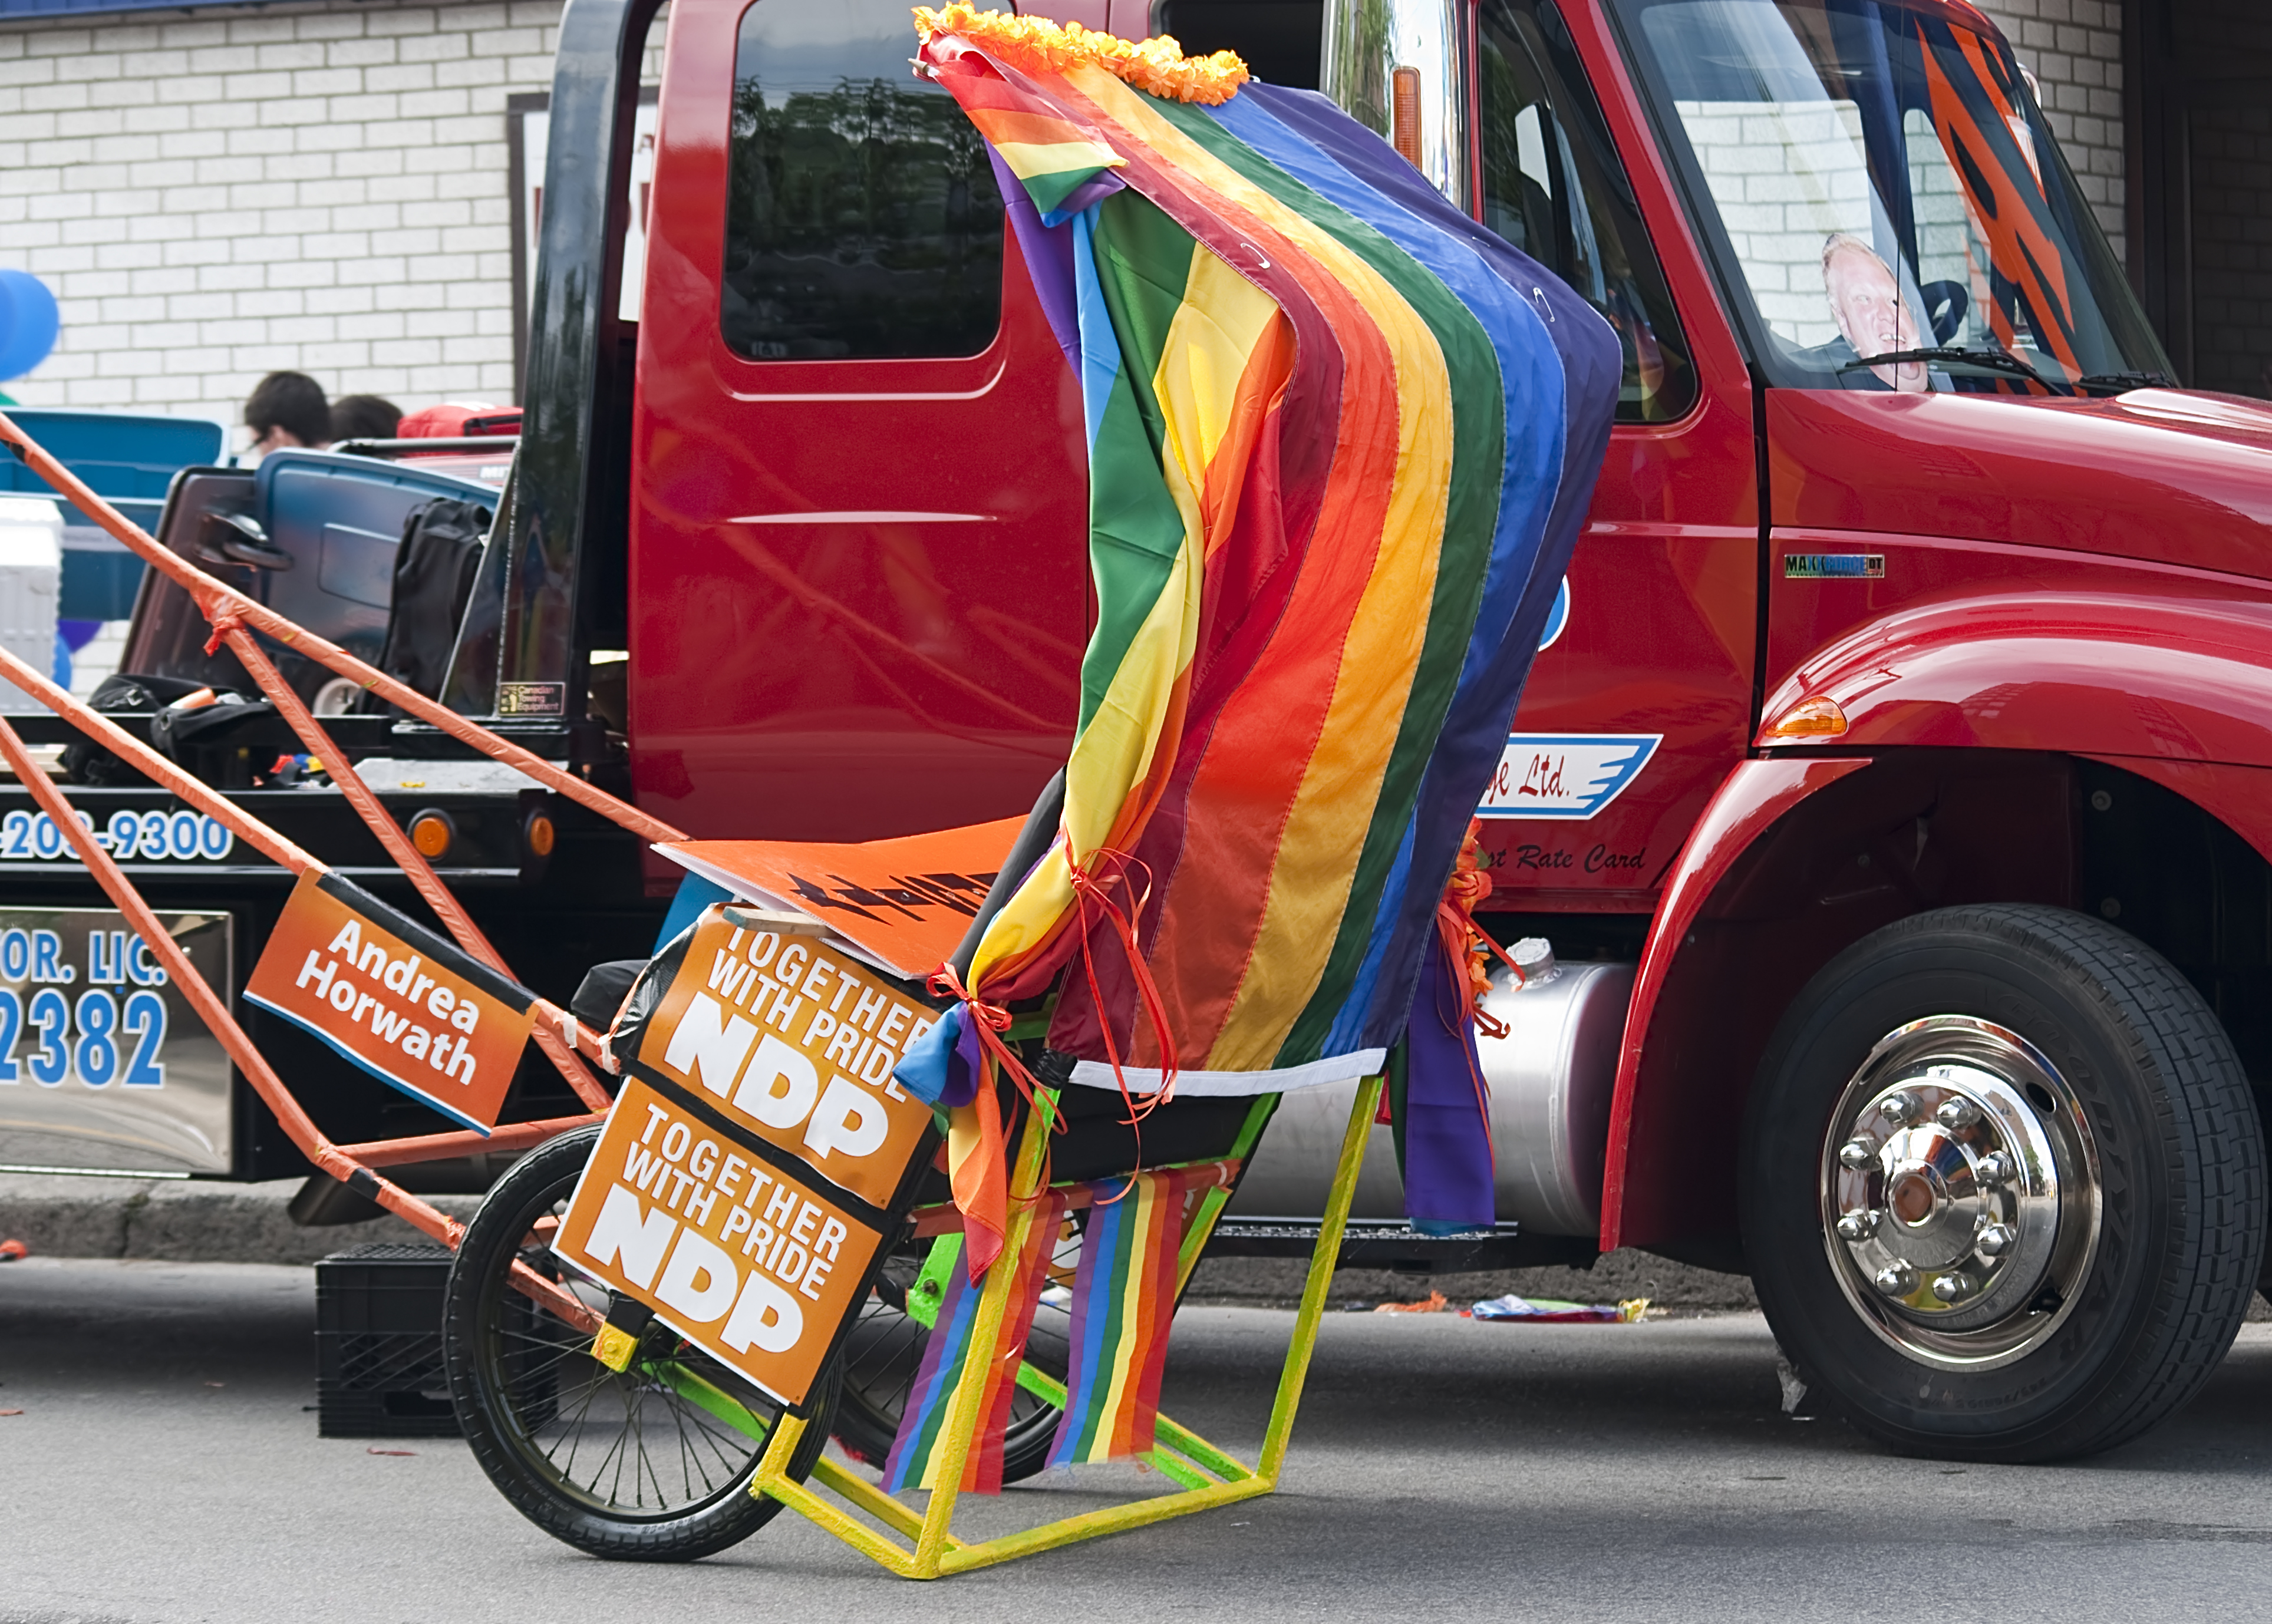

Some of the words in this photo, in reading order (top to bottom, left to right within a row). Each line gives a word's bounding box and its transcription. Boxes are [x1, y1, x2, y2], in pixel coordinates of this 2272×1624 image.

[1518, 753, 1569, 798] Ltd.
[1488, 849, 1507, 868] st
[1516, 844, 1574, 870] Rate
[1584, 843, 1646, 873] Card
[0, 928, 77, 984] OR.
[88, 930, 168, 986] LIC.
[295, 949, 476, 1086] Horwath
[328, 919, 480, 1035] Andrea
[707, 948, 803, 1032] WITH
[664, 991, 888, 1160] NDP
[622, 1142, 718, 1227] WITH
[719, 1204, 832, 1302] PRIDE
[640, 1103, 848, 1263] TOGETHER
[584, 1182, 803, 1355] NDP
